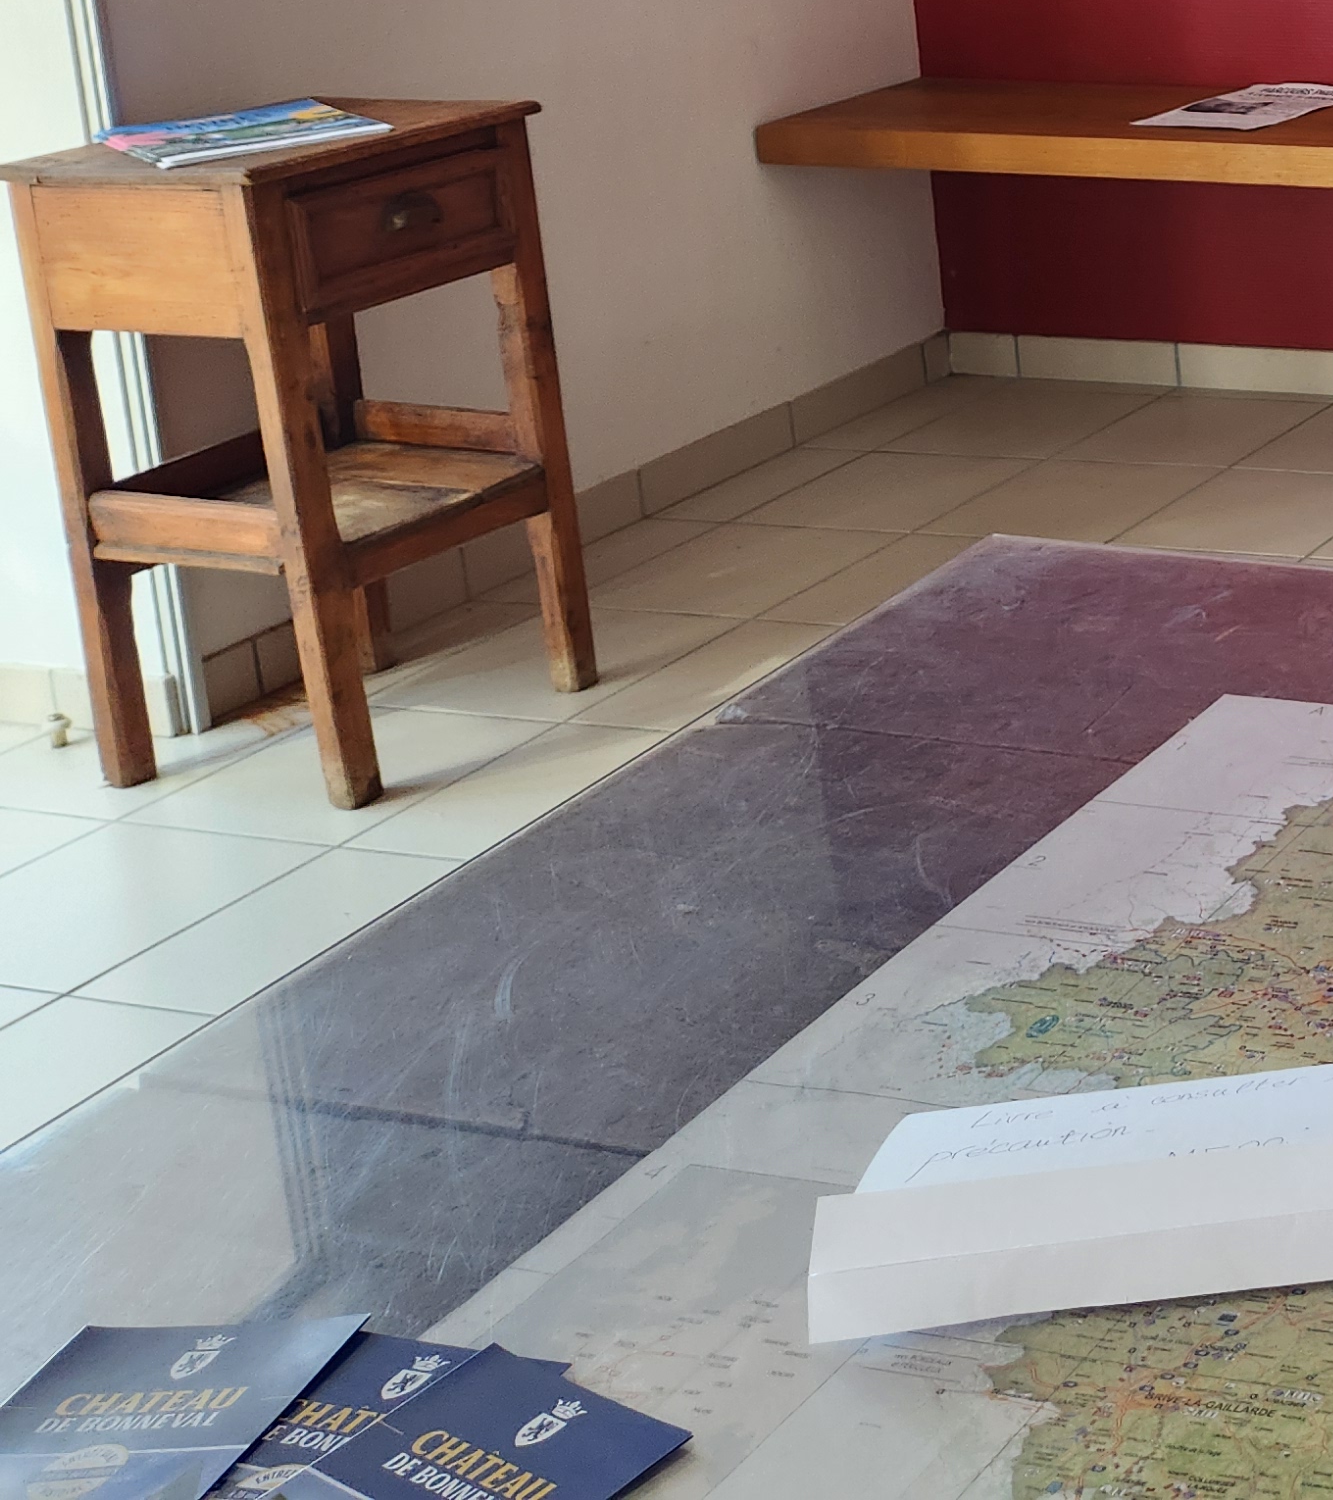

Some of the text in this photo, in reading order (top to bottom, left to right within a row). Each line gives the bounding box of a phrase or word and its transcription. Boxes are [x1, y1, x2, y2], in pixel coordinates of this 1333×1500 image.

[1028, 855, 1047, 867] 2
[970, 1109, 1054, 1129] Livre
[1151, 1076, 1310, 1106] consulter
[282, 1398, 386, 1434] HÂT
[1144, 1390, 1276, 1418] BRIVE-LA-GAILLARDE
[34, 1410, 221, 1434] DE BONNEVAL
[280, 1427, 351, 1453] BON
[382, 1452, 495, 1500] DE BONNE
